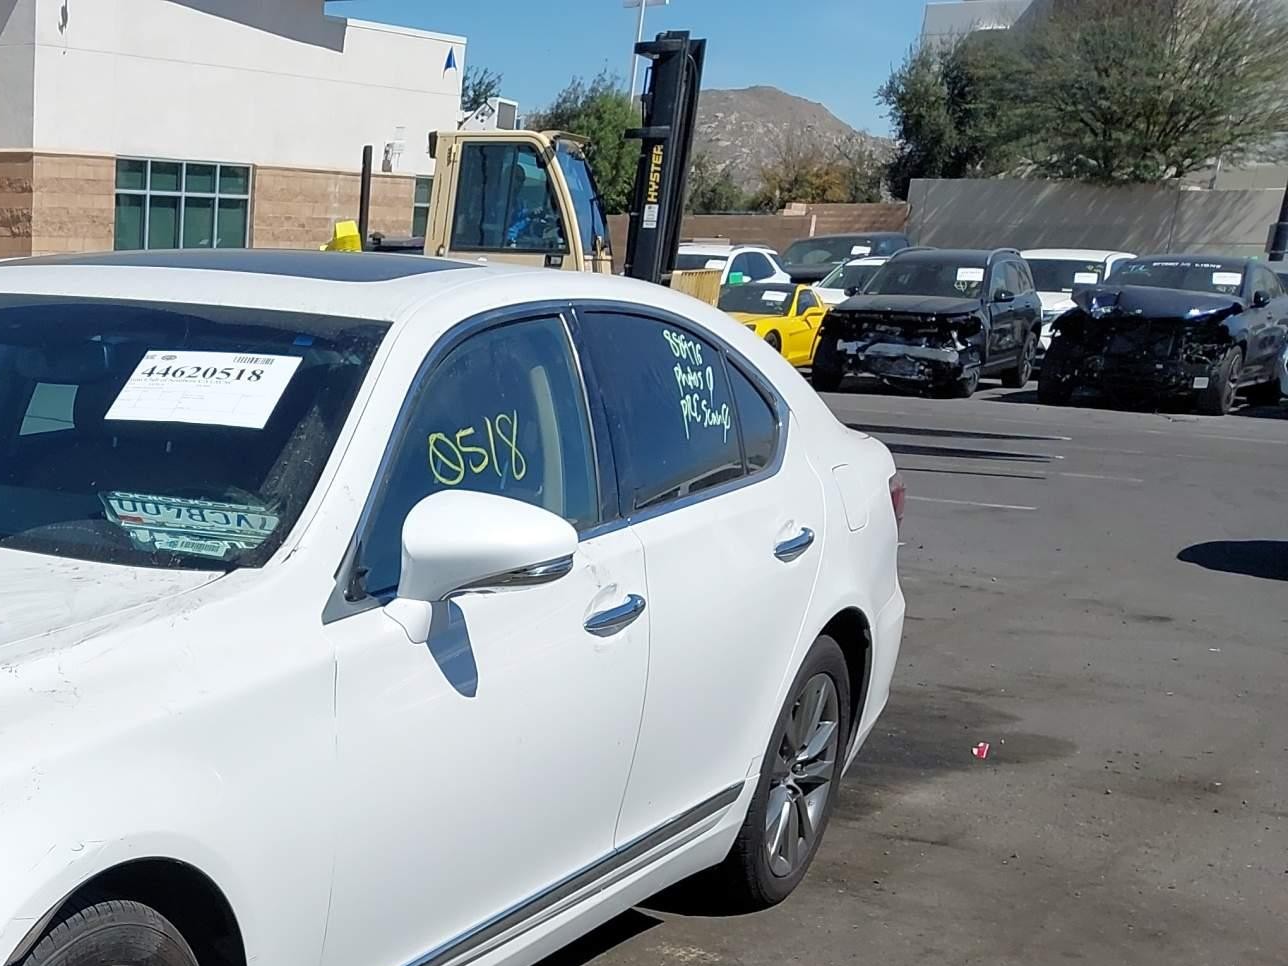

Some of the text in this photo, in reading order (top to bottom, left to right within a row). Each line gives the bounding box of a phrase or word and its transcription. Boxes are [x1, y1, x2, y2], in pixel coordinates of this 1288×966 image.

[647, 144, 664, 202] HYSTER
[141, 364, 265, 383] 44620518
[428, 409, 526, 486] 0518
